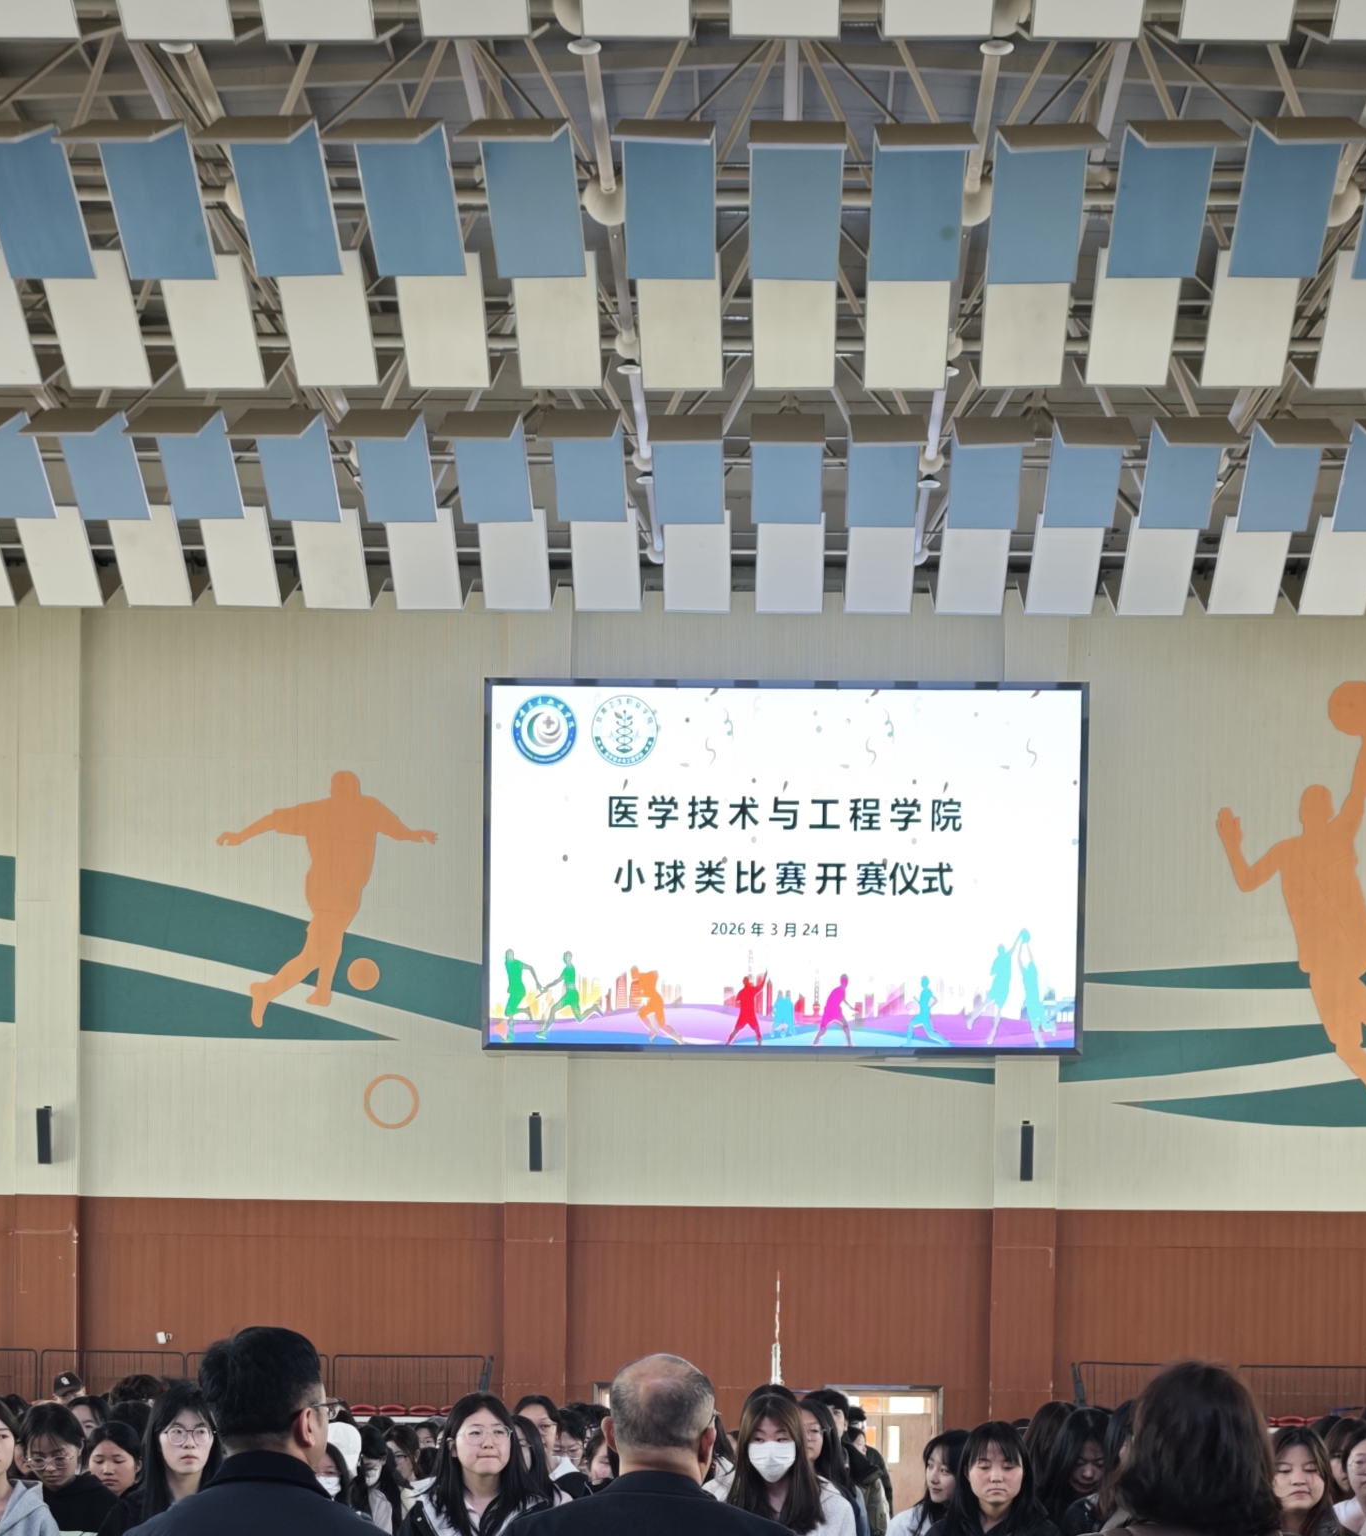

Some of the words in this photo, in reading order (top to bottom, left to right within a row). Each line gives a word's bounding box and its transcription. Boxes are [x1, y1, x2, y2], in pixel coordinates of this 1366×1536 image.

[607, 795, 963, 832] 医学技术与工程学院
[613, 859, 954, 897] 小球类比赛开赛仪式
